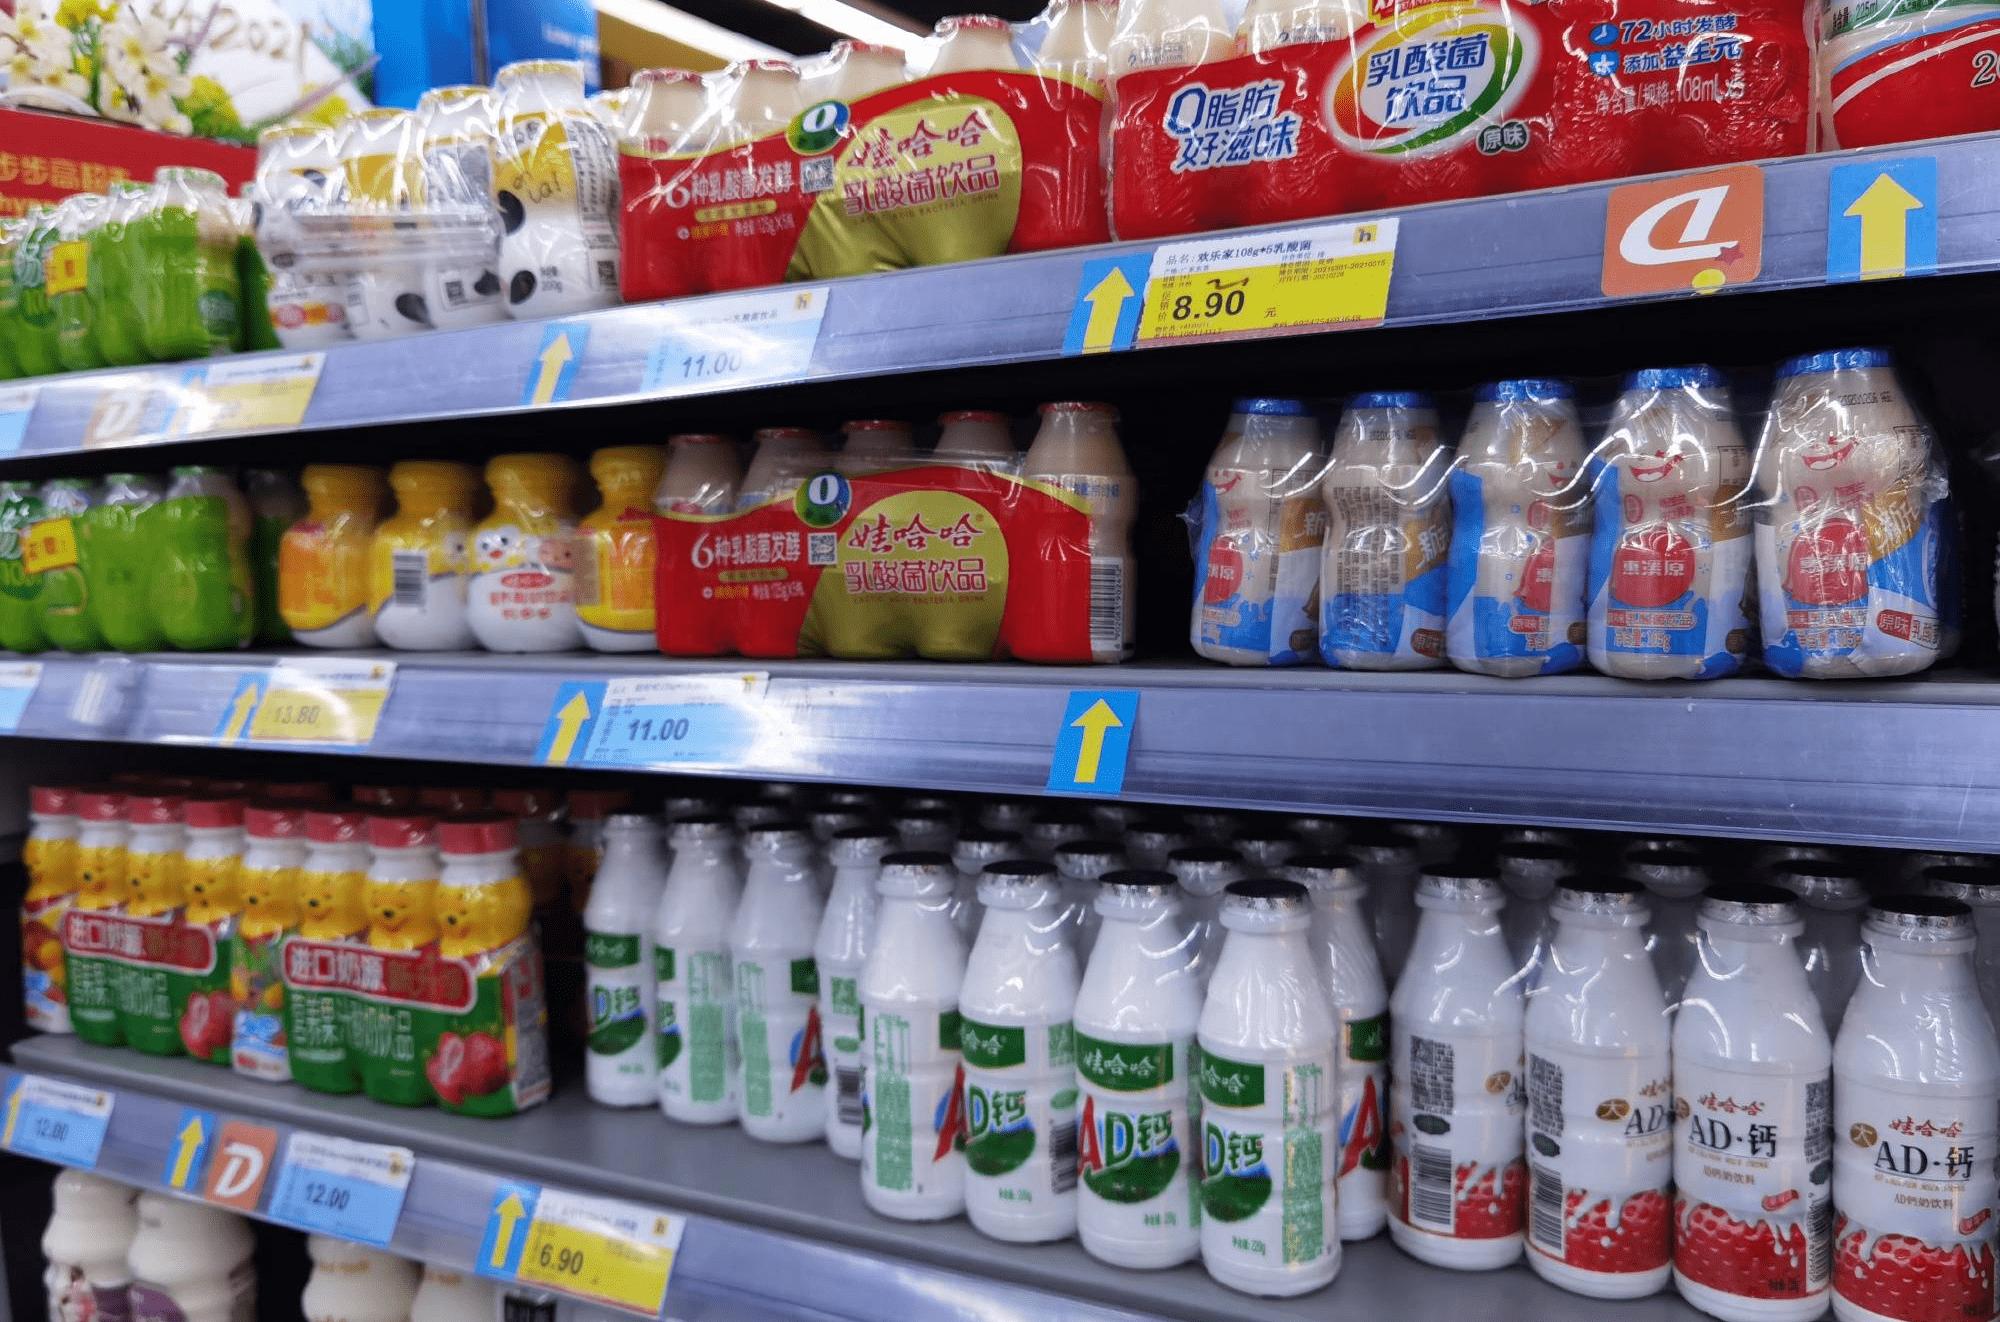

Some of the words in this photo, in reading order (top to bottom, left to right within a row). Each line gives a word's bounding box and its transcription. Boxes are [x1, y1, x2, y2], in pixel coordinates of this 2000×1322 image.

[1620, 14, 1737, 44] 72小时发酵
[1367, 33, 1488, 87] 乳酸菌
[1624, 36, 1743, 74] 添加益生元
[1971, 50, 2000, 88] 2
[1168, 84, 1279, 134] 0脂肪
[1385, 75, 1467, 122] 饮品
[848, 110, 988, 168] 娃哈哈
[1483, 126, 1524, 151] 原味
[844, 154, 999, 216] 乳酸菌饮品
[1172, 289, 1245, 321] 8.90
[682, 351, 743, 379] 11.00
[691, 531, 800, 569] 6种乳酸菌发酵
[848, 512, 984, 553] 娃哈哈
[845, 558, 987, 593] 乳酸菌饮品
[629, 717, 690, 742] 11.00
[1083, 1048, 1158, 1077] 娃哈哈
[1697, 1091, 1763, 1116] 娃哈哈
[1078, 1094, 1173, 1176] AD钙
[1888, 1115, 1962, 1138] 娃哈哈
[304, 1182, 351, 1211] 12.00
[539, 1243, 584, 1276] 6.90
